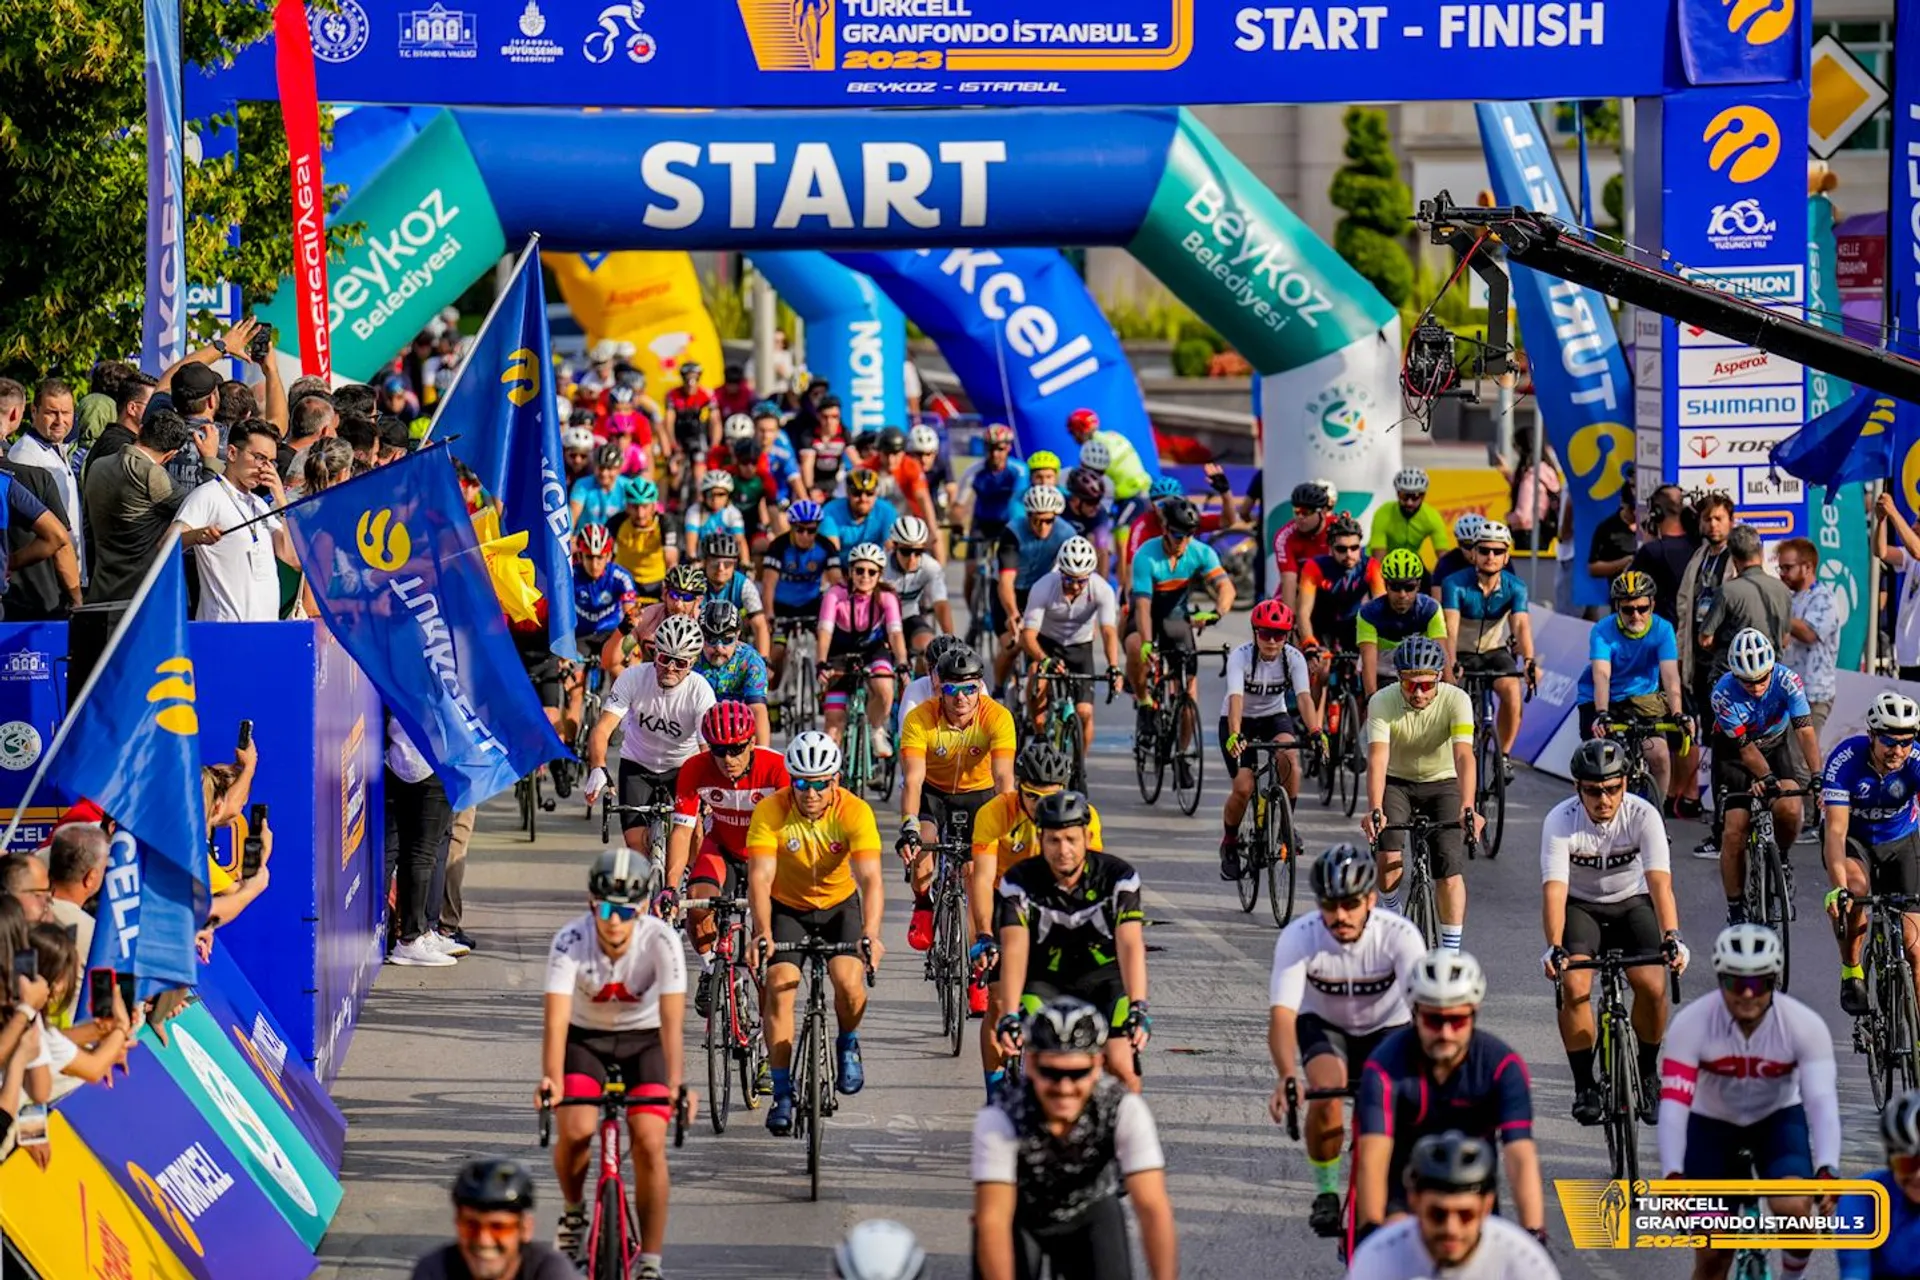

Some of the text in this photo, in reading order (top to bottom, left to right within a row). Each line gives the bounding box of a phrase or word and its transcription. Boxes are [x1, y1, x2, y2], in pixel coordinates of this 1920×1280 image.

[843, 0, 971, 17] TURKCELL
[1234, 7, 1388, 51] START
[1440, 1, 1604, 48] FINISH
[842, 19, 1158, 43] GRANFONDO İSTANBUL 3
[841, 50, 944, 69] 2023
[846, 81, 937, 93] BEYKOZ
[640, 140, 1007, 230] START
[351, 233, 462, 340] Belediyesi
[1181, 230, 1291, 332] Belediyesi
[939, 247, 1100, 397] kcell
[1713, 355, 1768, 377] Asperox
[1687, 396, 1796, 416] SHIMANO
[639, 712, 682, 738] KAS
[108, 829, 141, 960] CELL
[155, 1140, 235, 1223] TURKCELL
